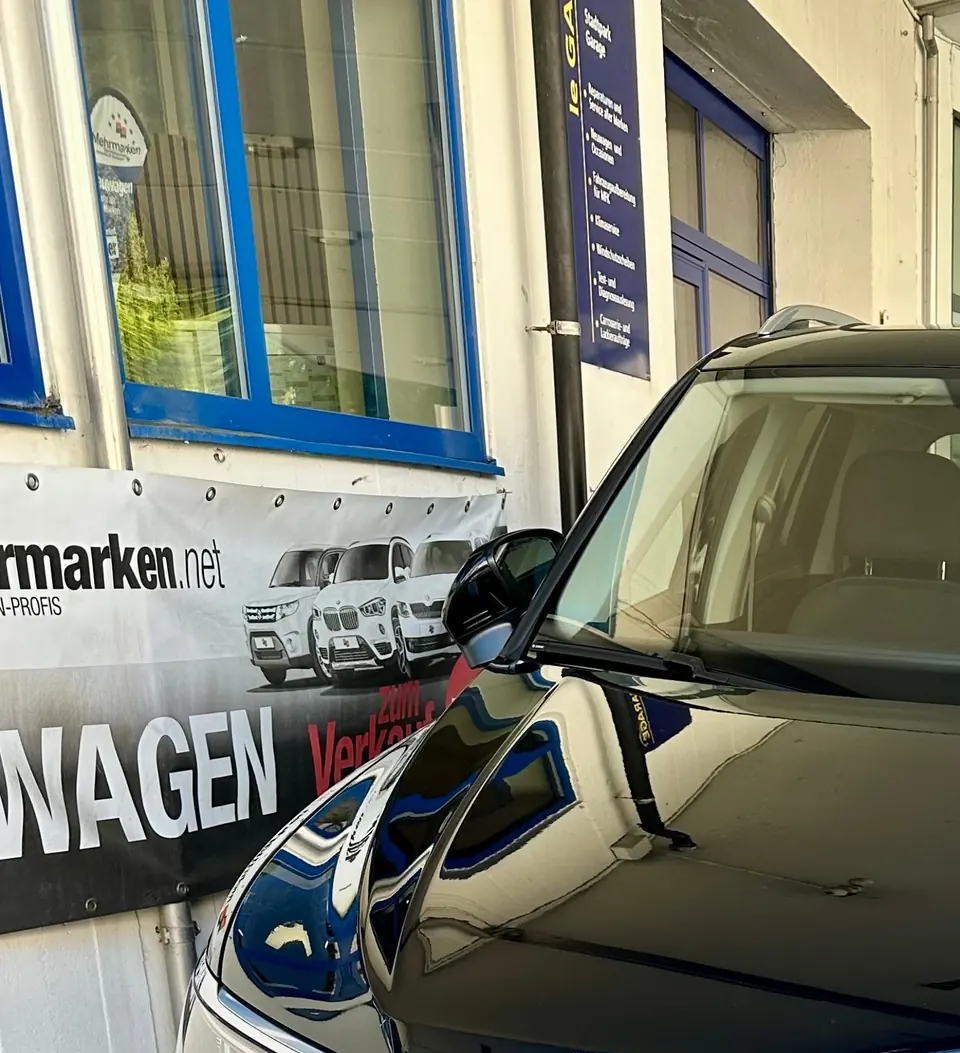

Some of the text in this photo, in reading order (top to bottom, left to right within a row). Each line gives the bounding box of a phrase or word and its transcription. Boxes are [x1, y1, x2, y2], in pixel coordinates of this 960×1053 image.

[584, 8, 612, 42] Stadtpark
[585, 30, 606, 59] Garage
[588, 82, 622, 115] Reparaturen und
[589, 97, 629, 134] Service aller Marken
[590, 127, 623, 157] Neuwagen und
[591, 141, 615, 166] Occasionen
[593, 184, 612, 205] für MFK
[594, 214, 620, 237] Klimaservice
[596, 242, 636, 271] Windschutzscheiben
[607, 277, 616, 289] und
[600, 327, 631, 350] Lackieraufträge
[622, 323, 631, 334] und
[378, 679, 420, 725] zum
[307, 700, 436, 797] Verk
